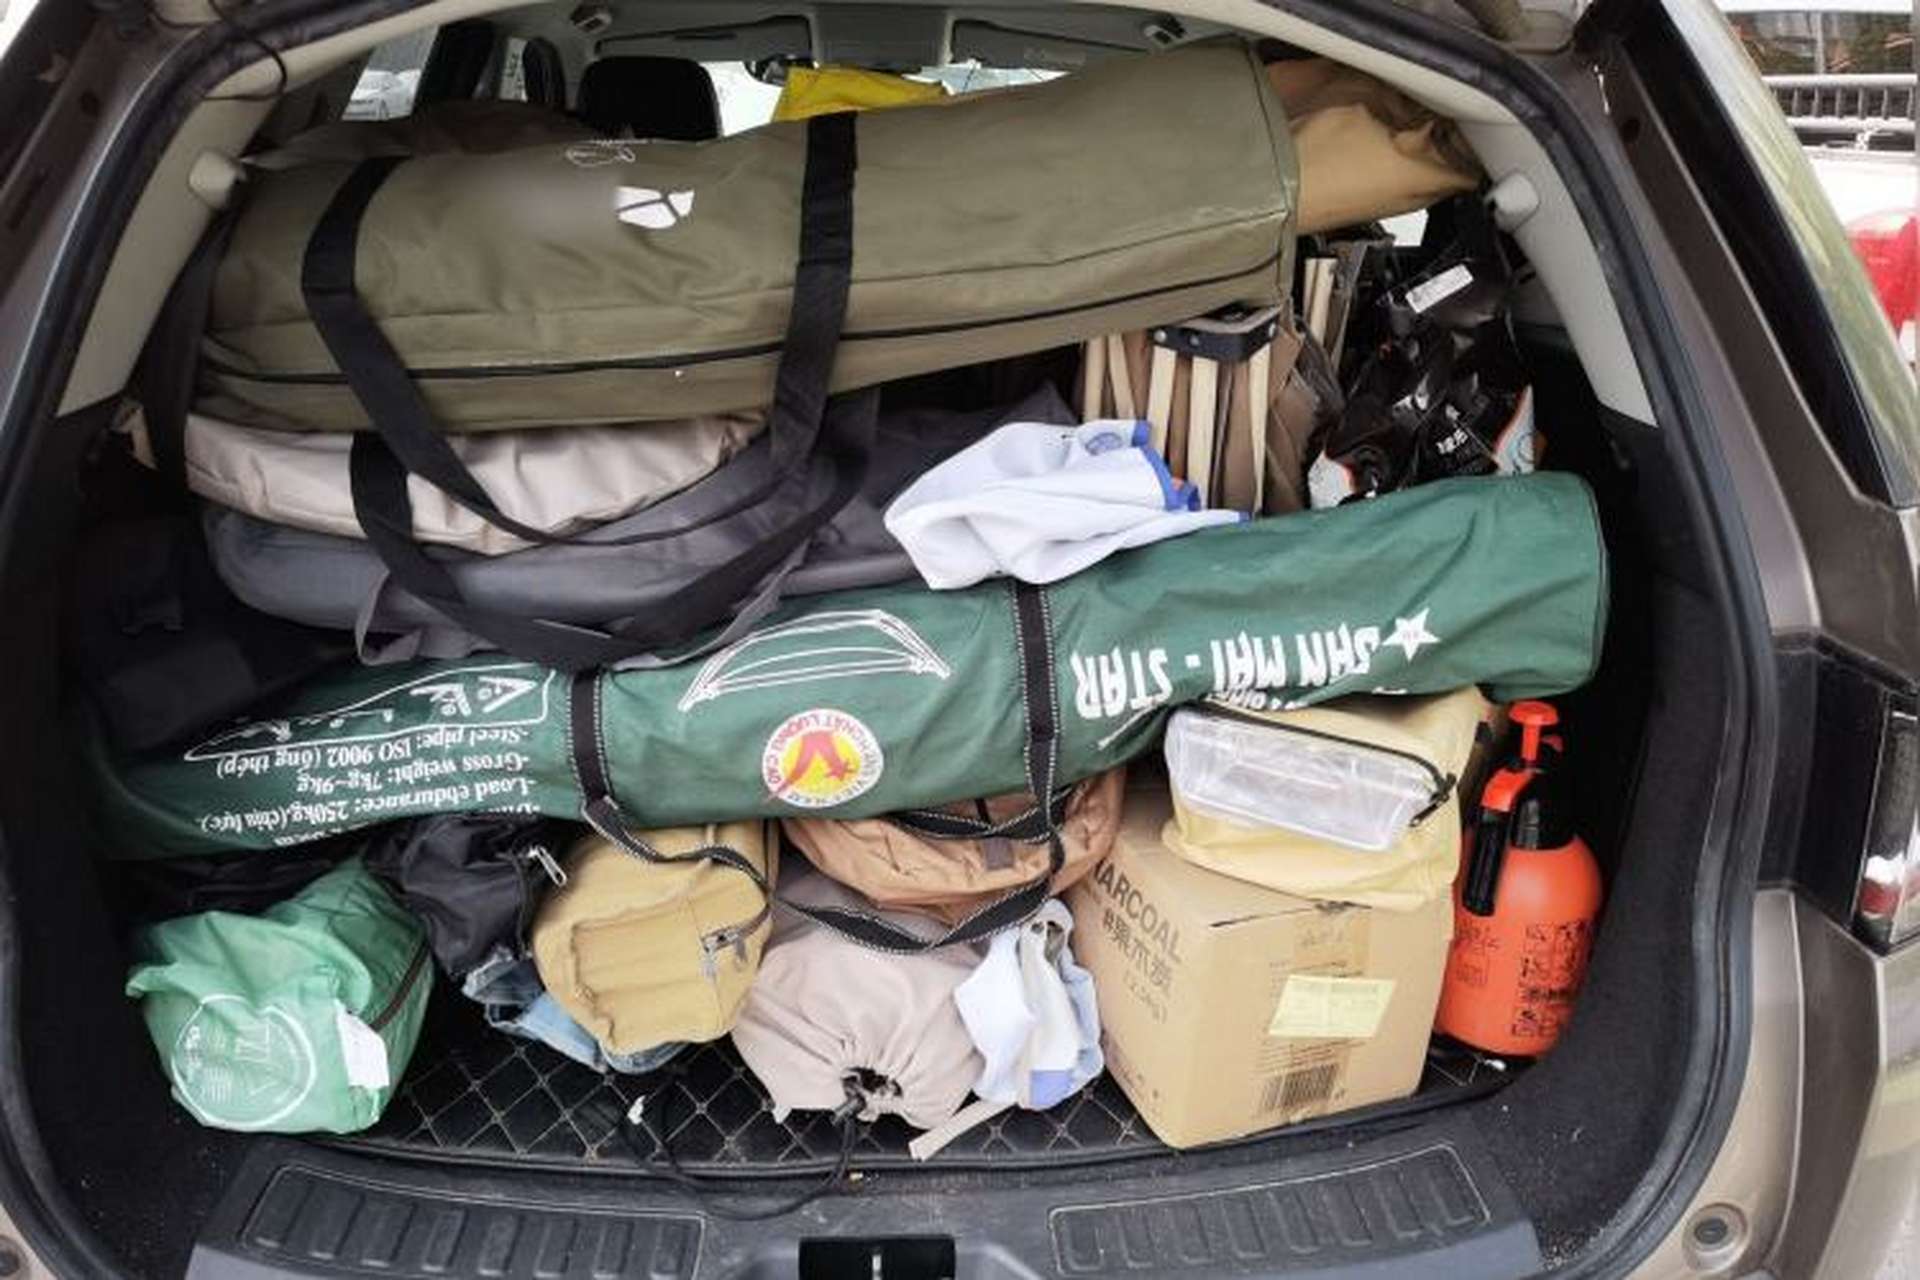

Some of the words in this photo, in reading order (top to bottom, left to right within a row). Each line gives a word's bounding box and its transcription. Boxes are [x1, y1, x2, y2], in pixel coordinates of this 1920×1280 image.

[1070, 646, 1174, 720] STAR
[379, 738, 412, 761] ISO
[418, 727, 463, 751] pipe:
[326, 744, 374, 767] 9002
[387, 758, 456, 785] weight:
